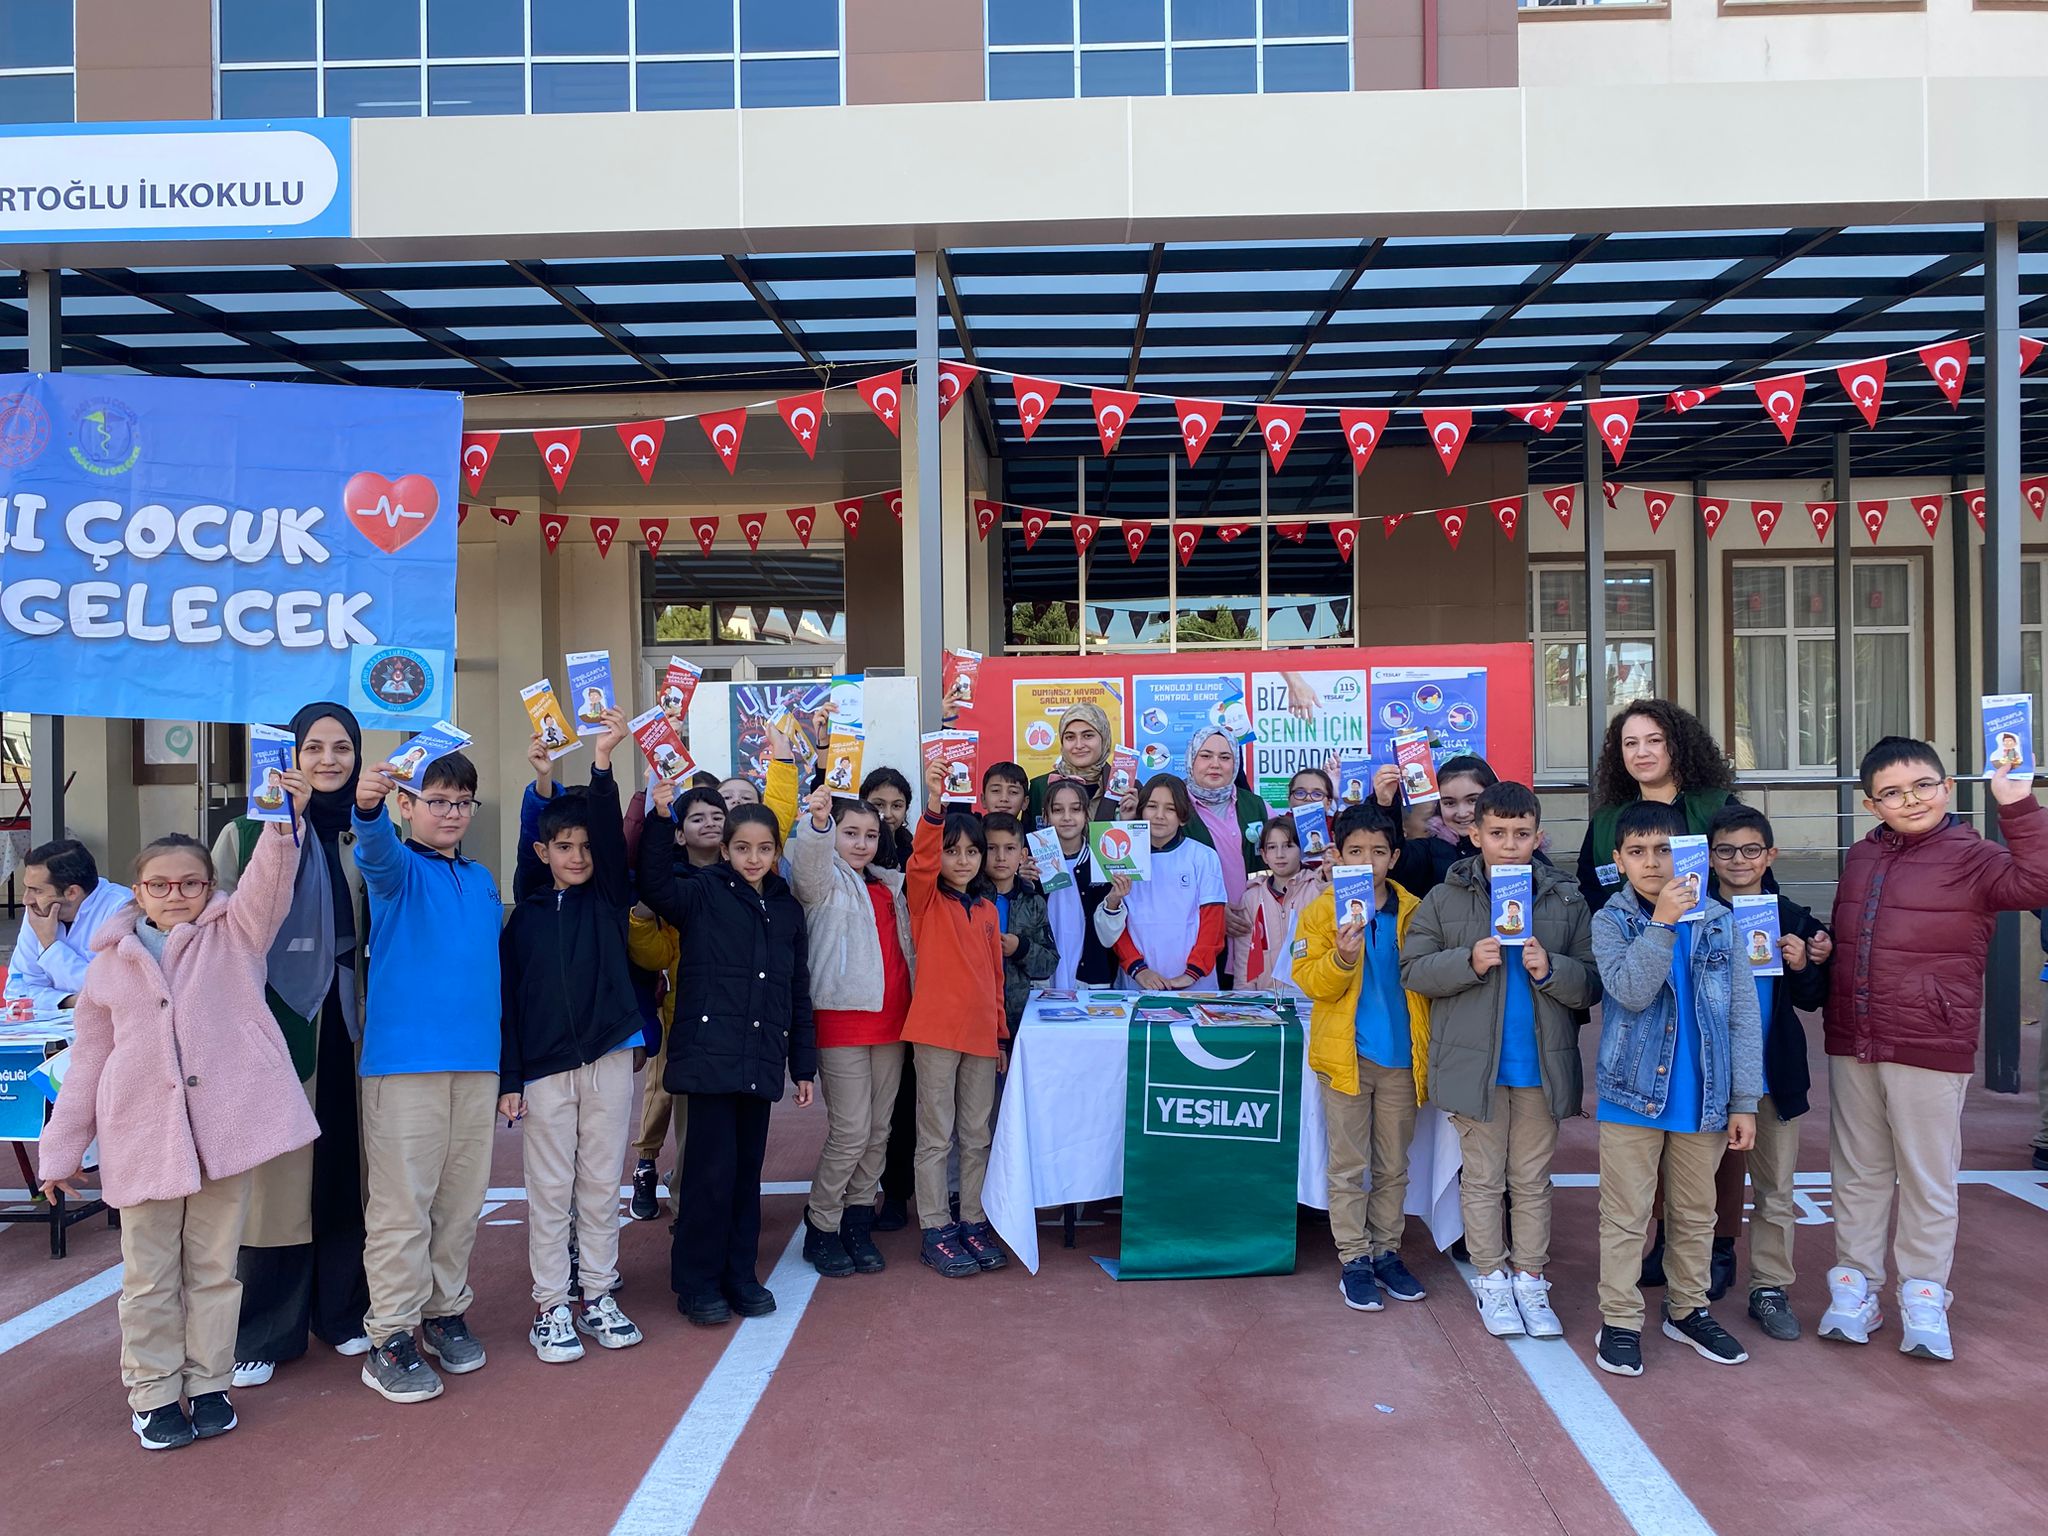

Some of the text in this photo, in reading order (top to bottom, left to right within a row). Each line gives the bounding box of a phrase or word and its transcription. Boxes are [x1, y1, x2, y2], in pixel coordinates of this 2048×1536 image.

[139, 178, 304, 209] İLKOKULU
[65, 500, 331, 571] ÇOCUK
[1, 578, 377, 649] GELECEK
[1074, 688, 1105, 696] HAVADA
[1154, 692, 1218, 702] KONTROL BENDE
[1257, 682, 1287, 711] BİZ
[1339, 683, 1355, 691] 115
[1324, 712, 1363, 745] İÇİN
[1156, 1096, 1271, 1128] YEŞİLAY
